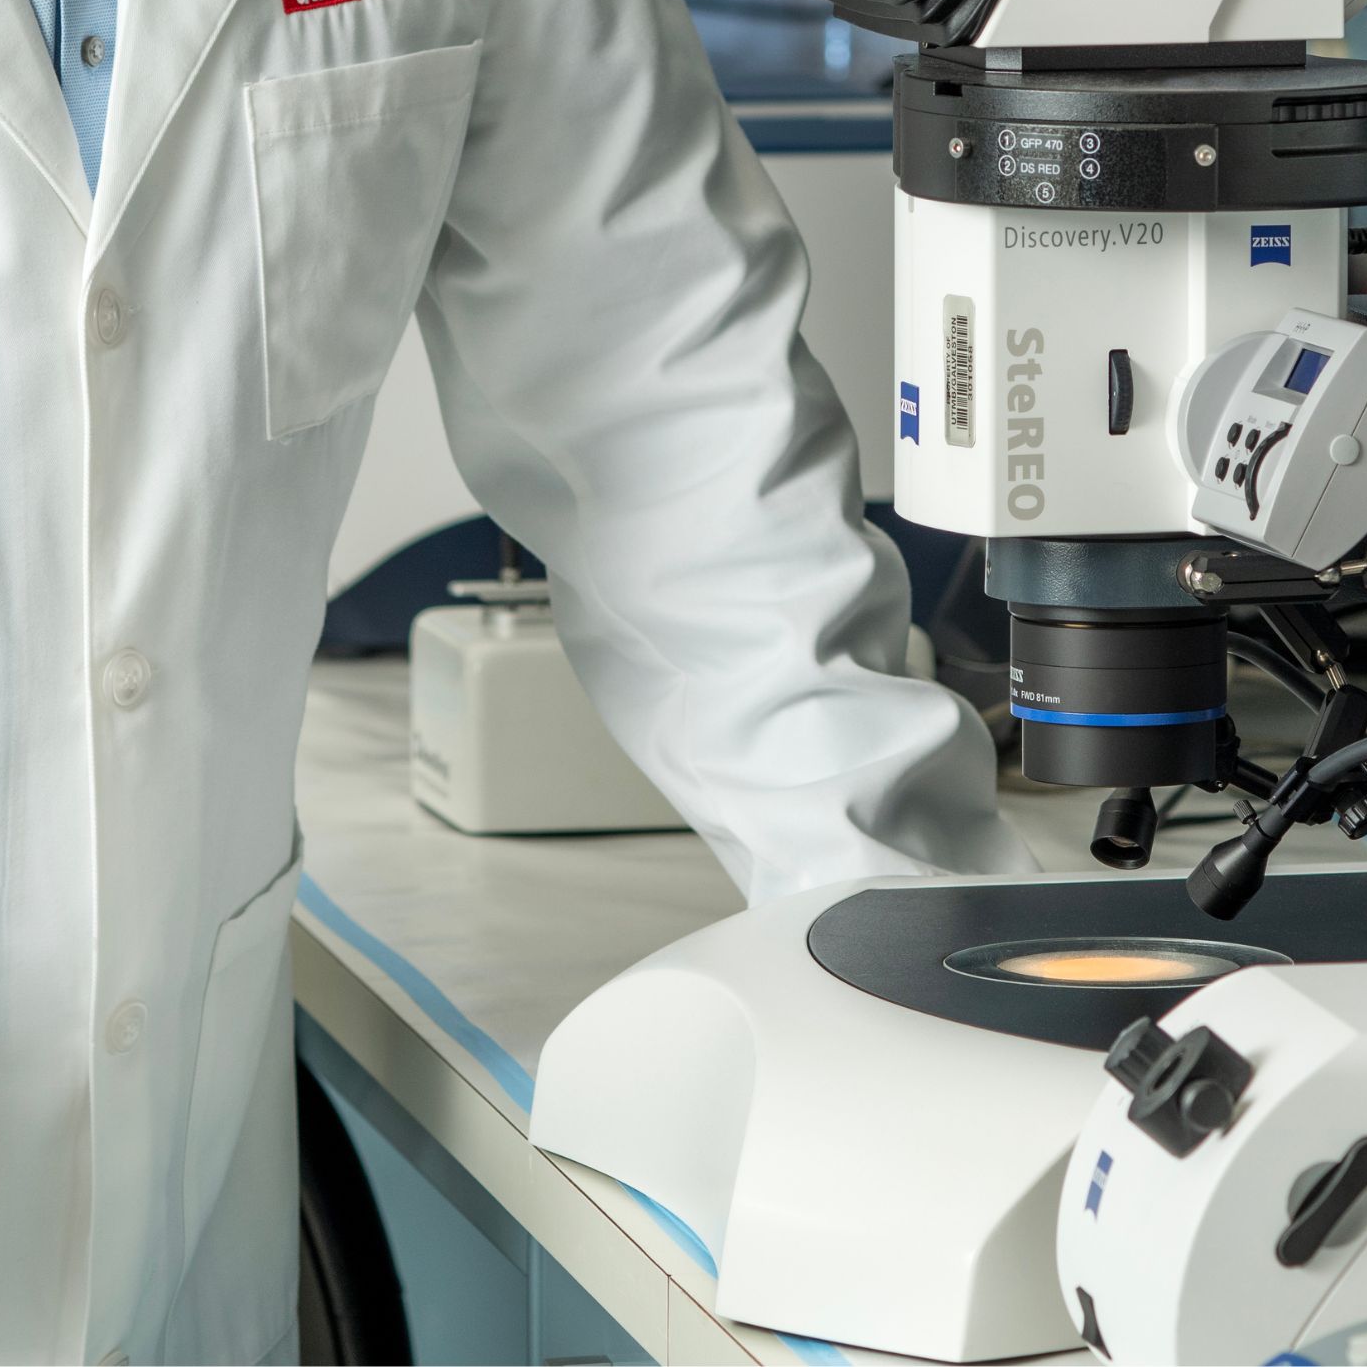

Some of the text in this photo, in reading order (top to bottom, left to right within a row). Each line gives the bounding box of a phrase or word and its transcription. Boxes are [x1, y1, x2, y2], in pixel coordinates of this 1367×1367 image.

[1020, 137, 1042, 149] GFP
[1044, 139, 1063, 151] 470
[1020, 162, 1035, 174] DS
[1038, 164, 1061, 175] RED
[1005, 222, 1164, 252] Discovery.V20
[1252, 236, 1290, 248] ZEISS
[1006, 327, 1046, 521] SteREO
[1020, 690, 1035, 701] FWD
[1036, 693, 1061, 704] 81mm
